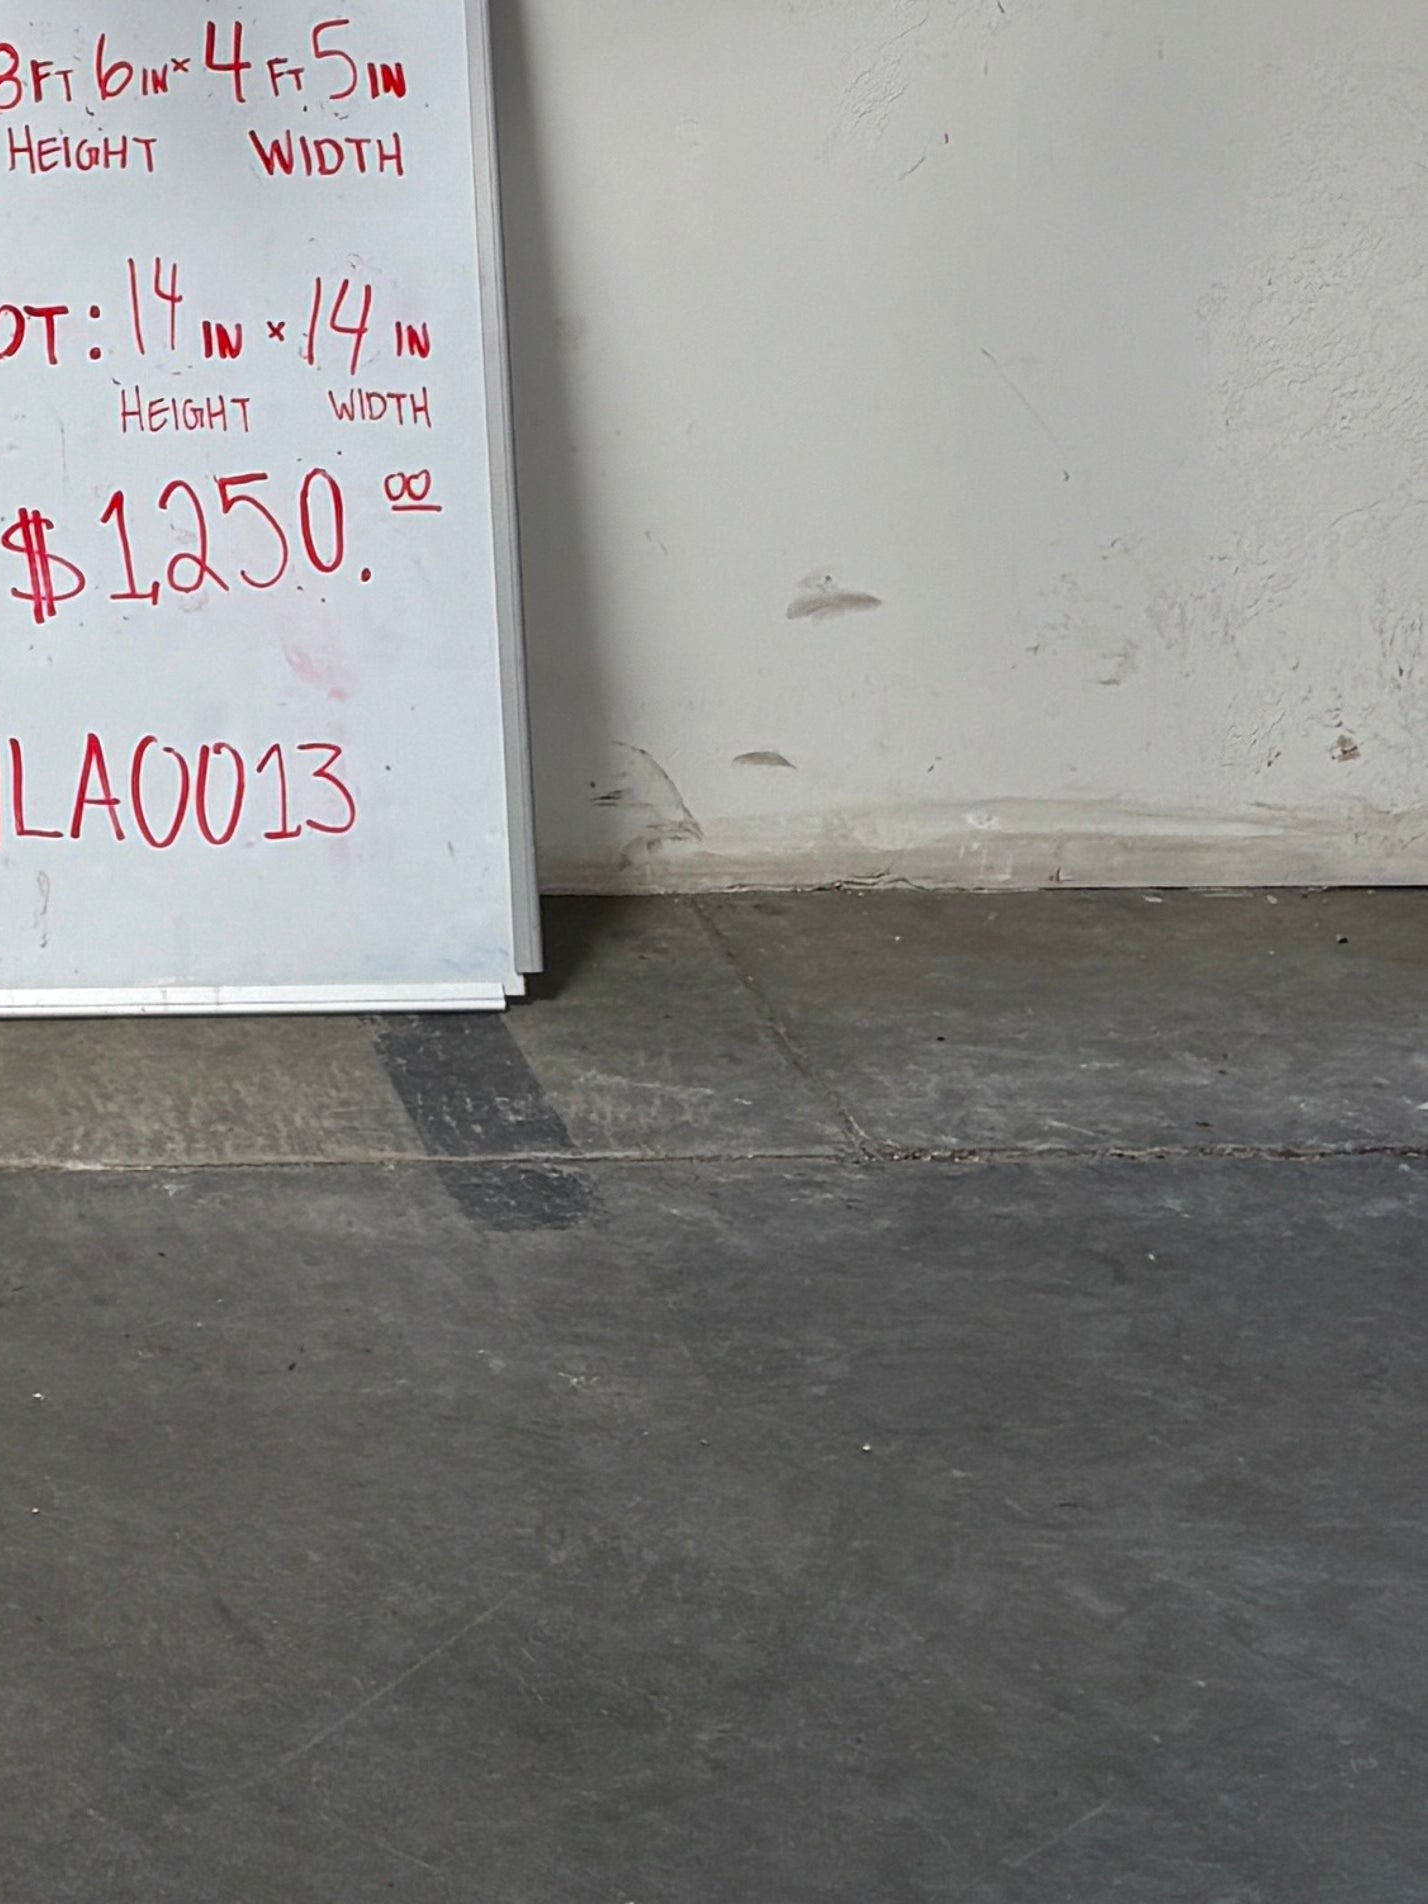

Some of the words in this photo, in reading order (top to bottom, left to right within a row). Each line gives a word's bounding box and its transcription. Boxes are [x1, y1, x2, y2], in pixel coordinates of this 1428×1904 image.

[6, 124, 158, 175] HEIGHT
[248, 128, 405, 177] WIDTH
[119, 384, 251, 434] HEIGHT
[327, 385, 433, 429] WIDTH
